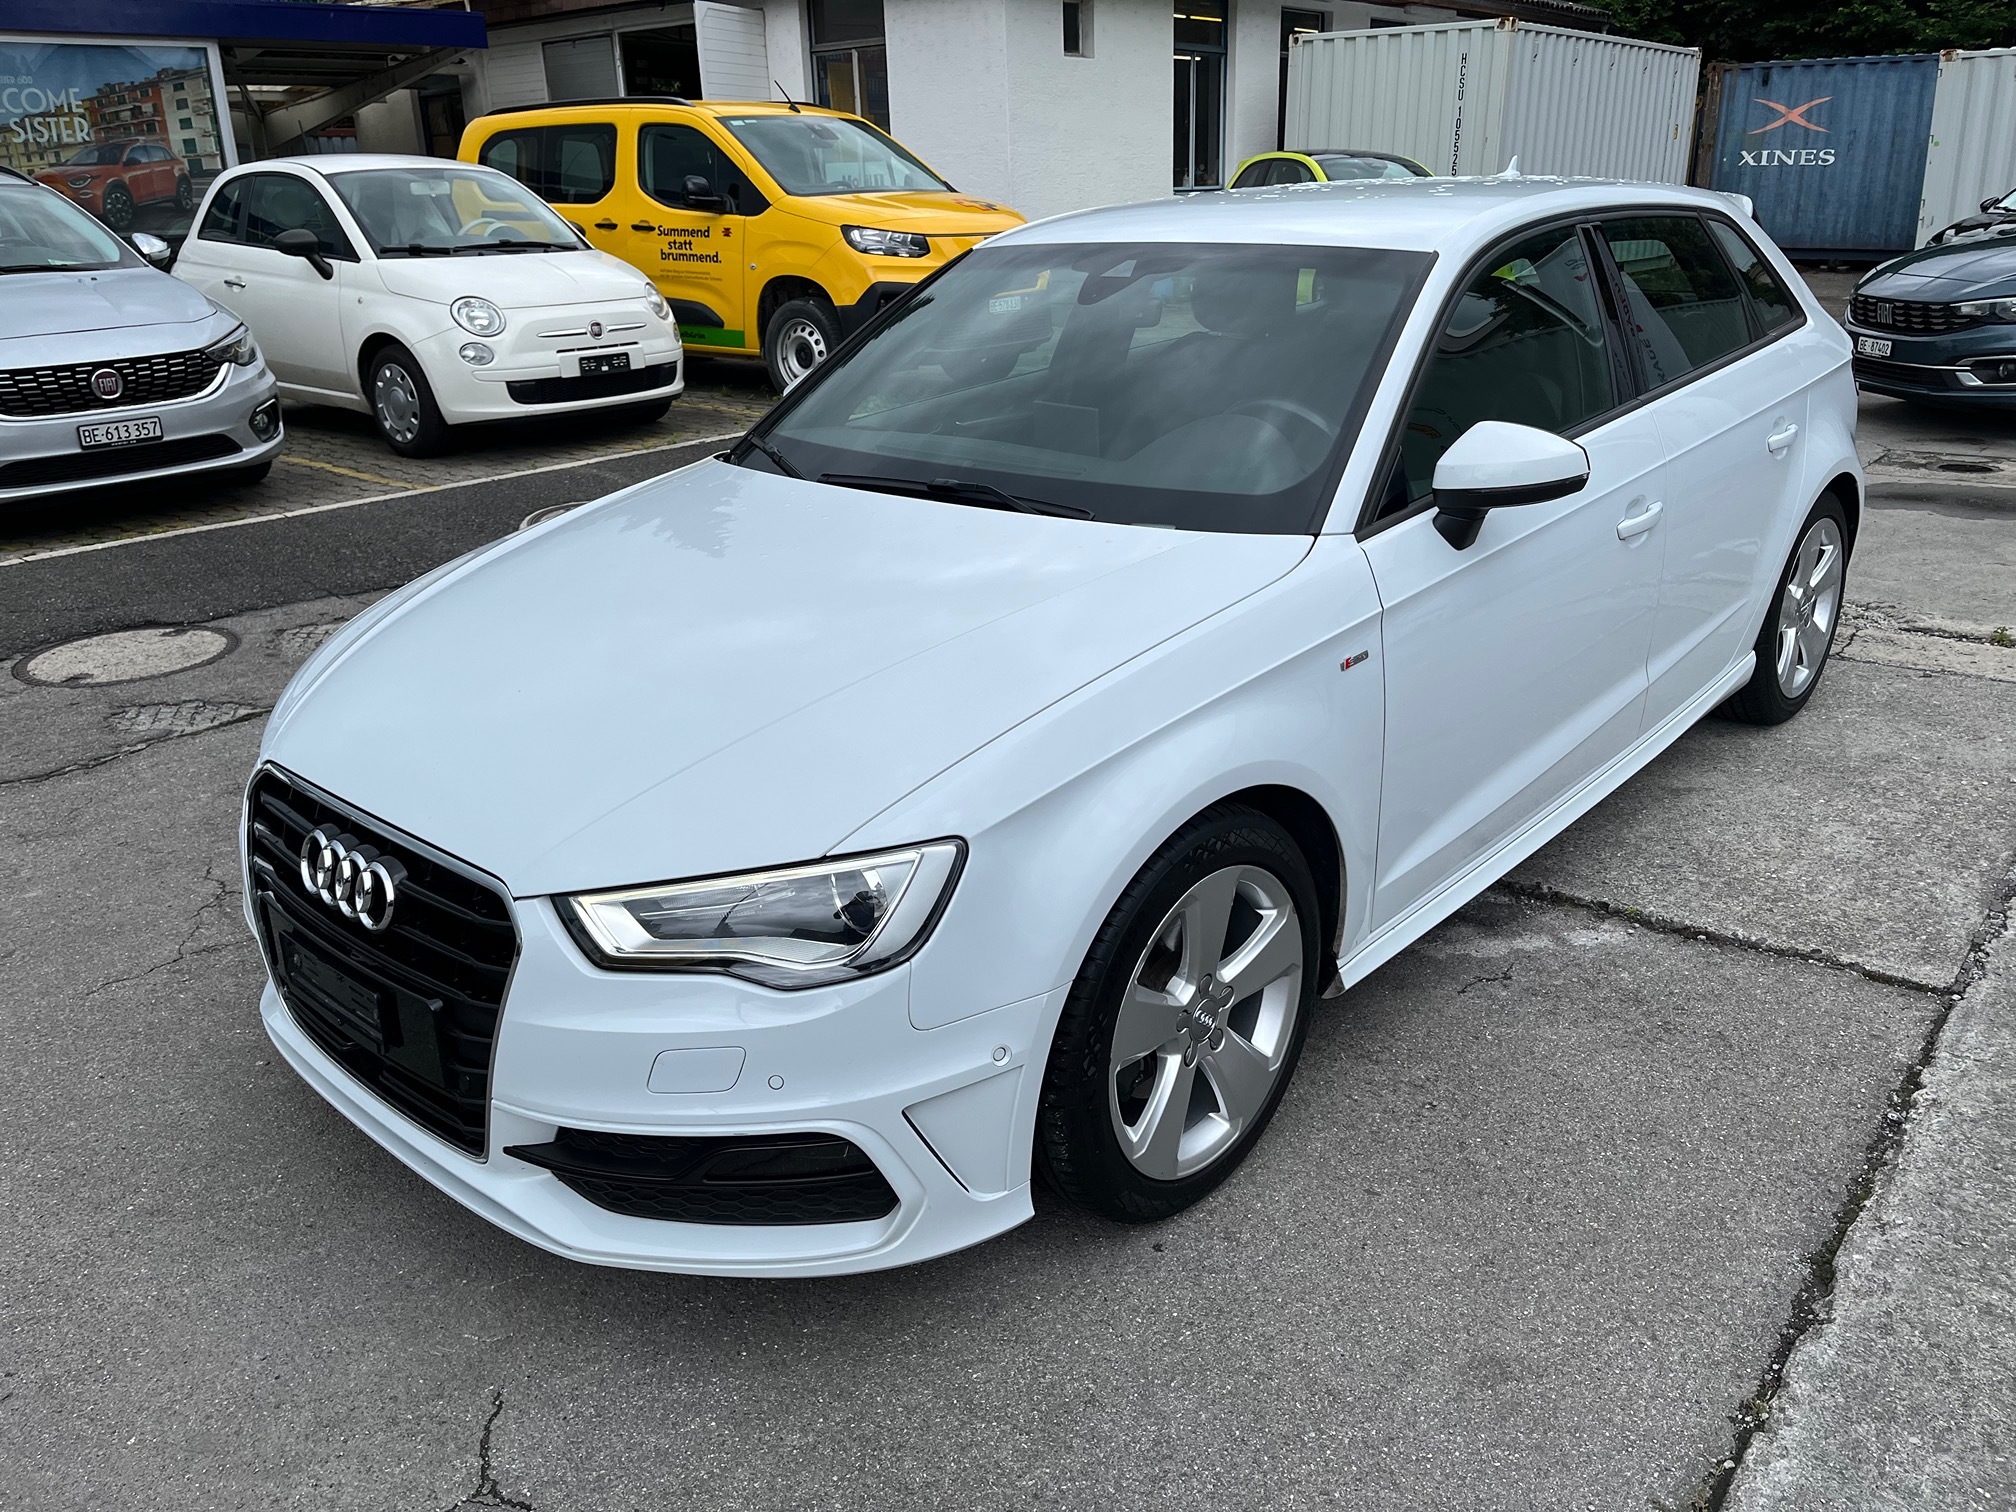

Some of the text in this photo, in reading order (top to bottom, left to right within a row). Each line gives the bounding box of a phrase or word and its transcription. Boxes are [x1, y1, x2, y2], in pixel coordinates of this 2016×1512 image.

[1451, 52, 1468, 176] HCSU 105525
[9, 116, 92, 144] SISTER
[1737, 148, 1836, 167] XINES
[657, 224, 711, 239] Summend
[667, 239, 694, 251] statt
[660, 248, 722, 264] brummend.
[1877, 302, 1894, 325] FIAT
[98, 377, 117, 392] FIAT
